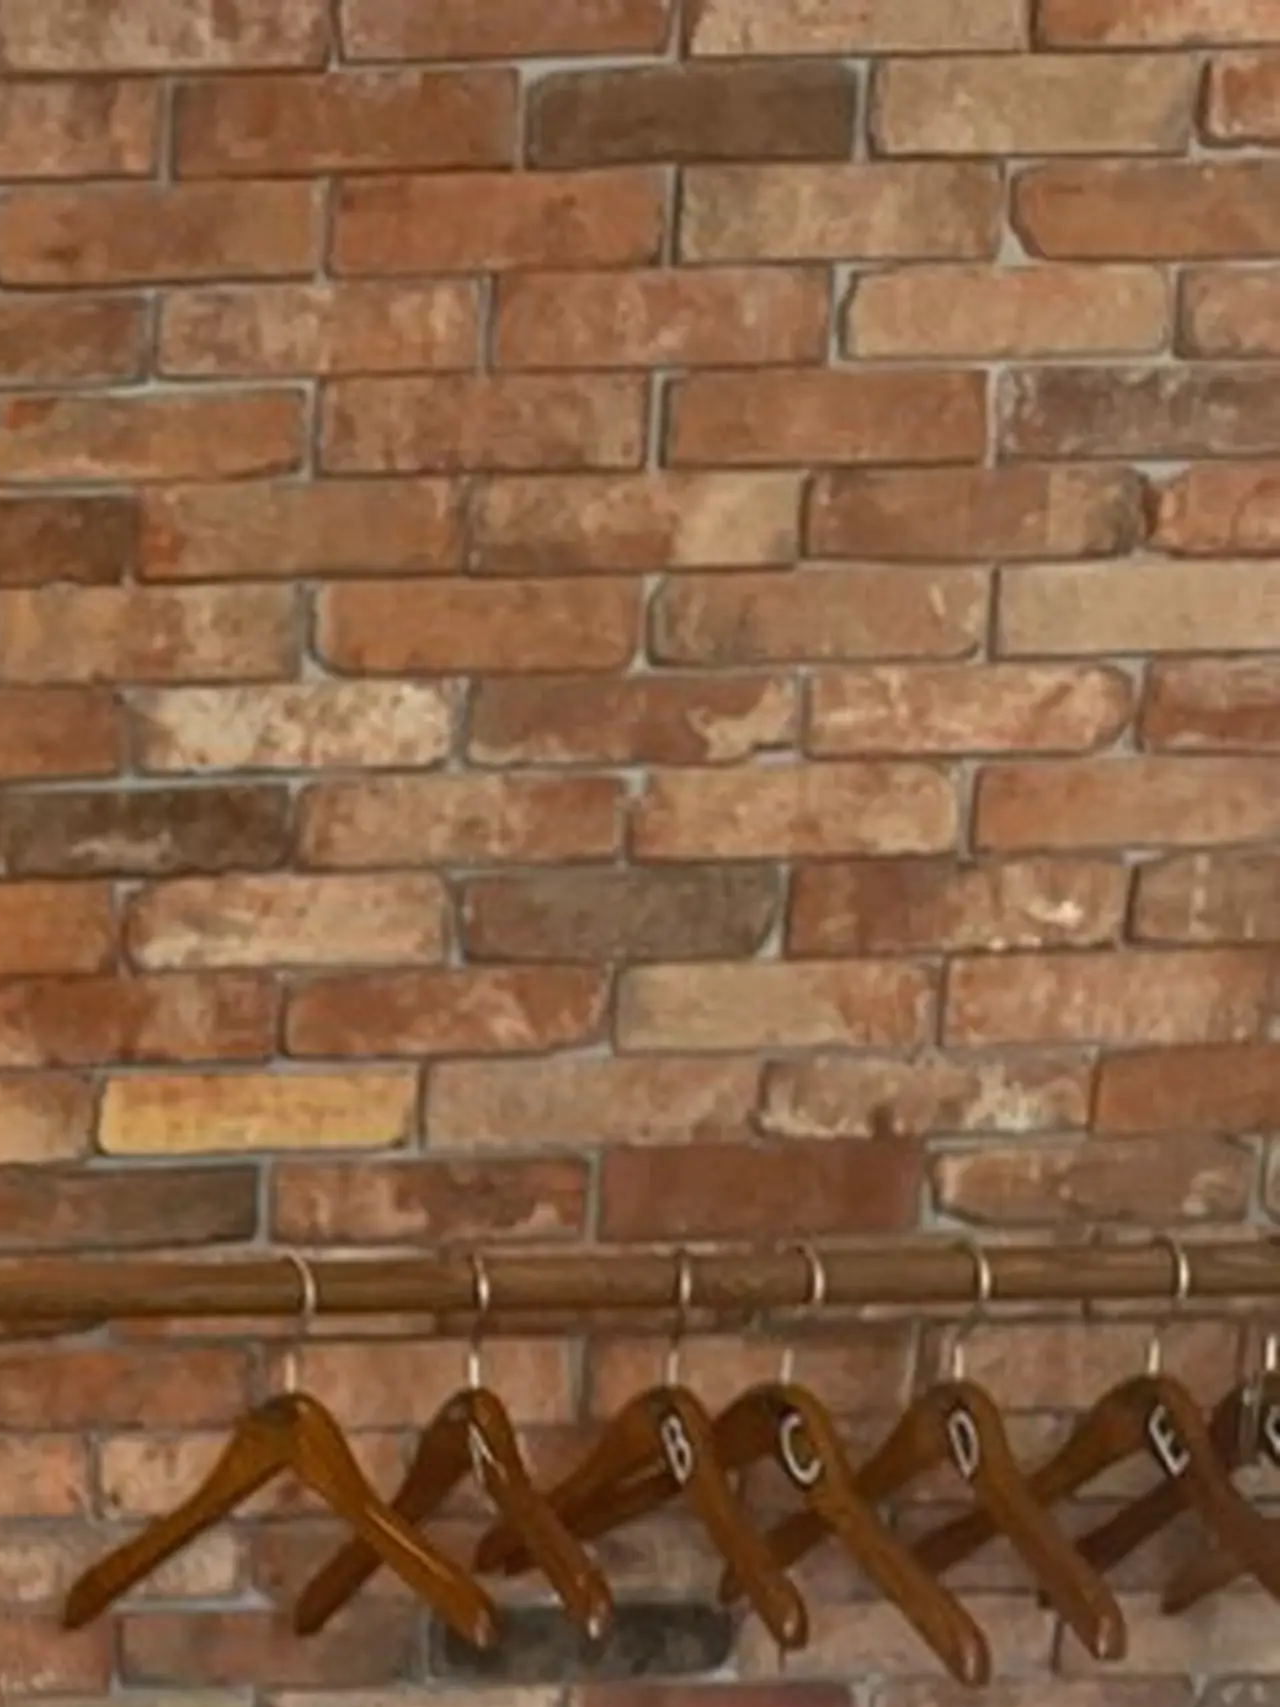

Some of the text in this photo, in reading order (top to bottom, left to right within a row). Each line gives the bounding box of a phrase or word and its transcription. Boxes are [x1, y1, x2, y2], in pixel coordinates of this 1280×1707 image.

[660, 1414, 692, 1484] B
[780, 1412, 822, 1485] C
[949, 1409, 979, 1477] D
[1148, 1404, 1190, 1477] E
